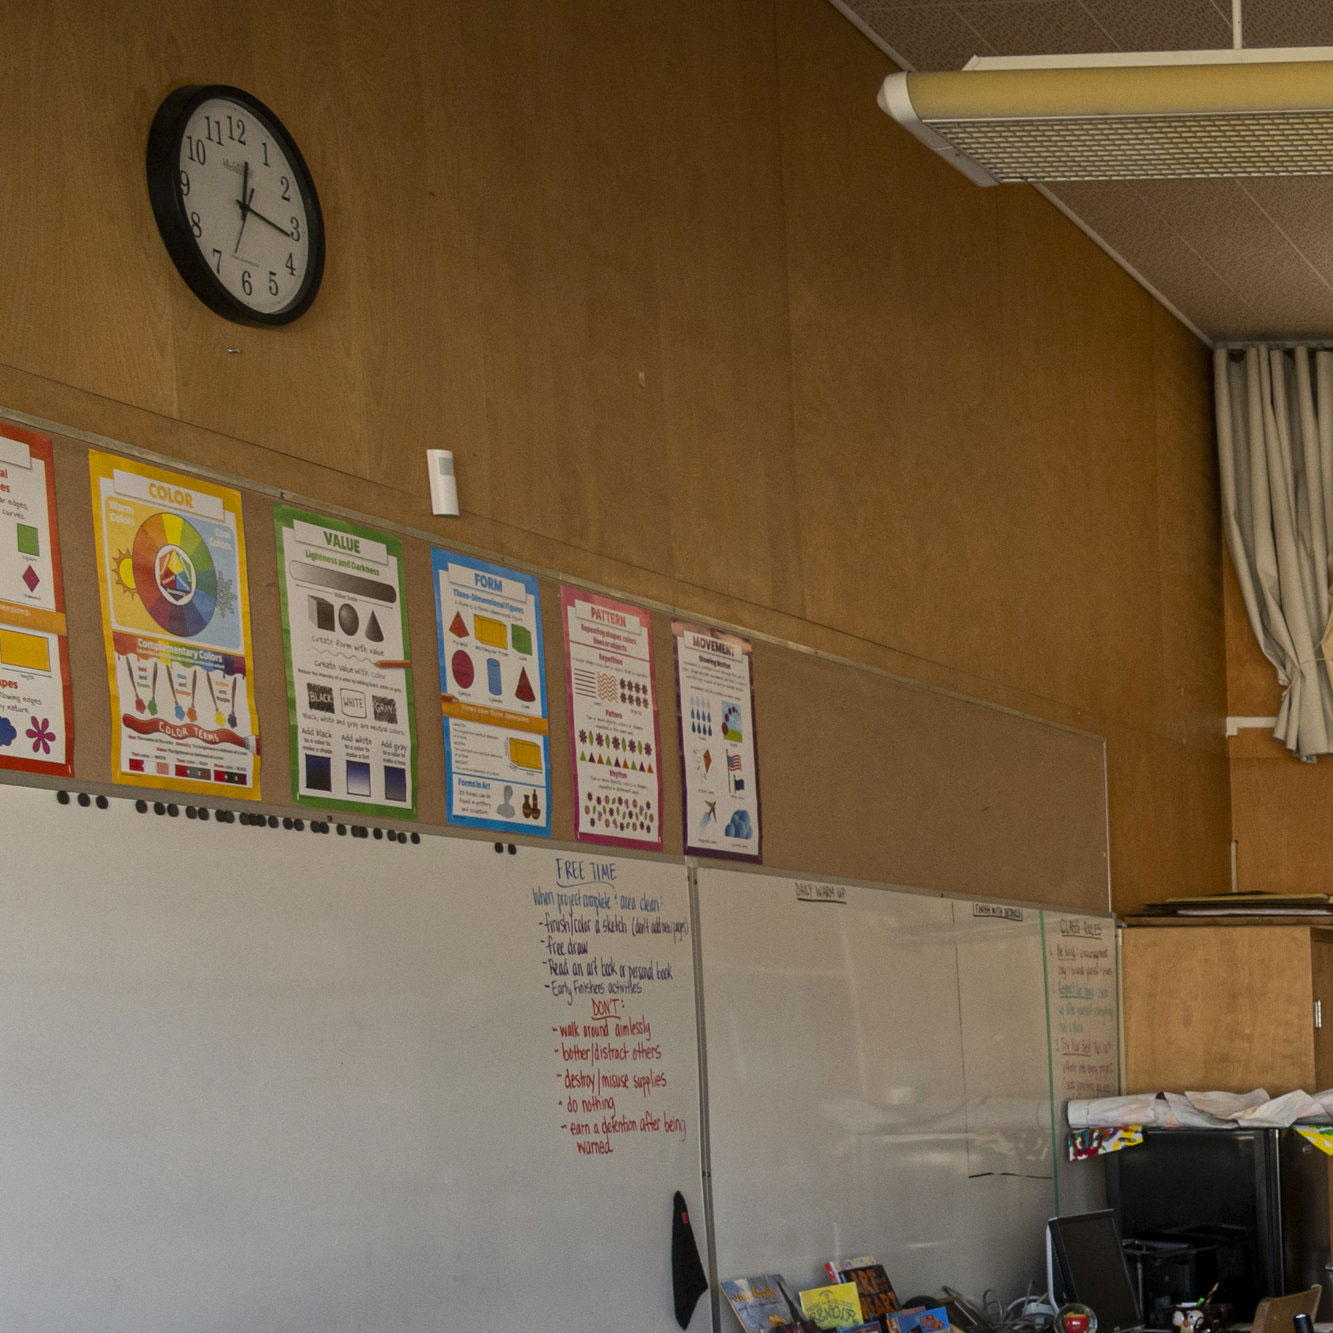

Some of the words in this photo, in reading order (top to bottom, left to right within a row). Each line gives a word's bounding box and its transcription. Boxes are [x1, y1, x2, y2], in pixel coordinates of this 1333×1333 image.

[205, 115, 224, 146] 11
[227, 116, 246, 146] 12
[187, 135, 206, 165] 10
[262, 142, 271, 168] 1
[180, 170, 190, 196] 9
[280, 176, 290, 202] 2
[191, 212, 202, 238] 8
[290, 217, 300, 241] 3
[212, 248, 224, 275] 7
[285, 252, 296, 277] 4
[241, 270, 253, 296] 6
[268, 271, 279, 297] 5
[148, 483, 194, 508] COLOR
[323, 531, 361, 554] VALUE
[305, 549, 337, 566] Lightness
[338, 559, 351, 569] and
[351, 561, 380, 576] Darkness
[474, 573, 503, 592] FORM
[591, 606, 626, 627] PATTERN
[137, 638, 199, 659] Complementary
[199, 649, 223, 663] Colors
[693, 635, 735, 657] MOVEMENT
[309, 691, 332, 703] BLACK
[342, 696, 364, 709] WHITE
[375, 703, 394, 714] GRAY
[605, 709, 623, 719] Pattern
[158, 721, 188, 739] COLOR
[193, 727, 220, 743] TERMS
[302, 728, 315, 736] Add
[316, 729, 333, 739] black
[341, 734, 354, 743] Add
[355, 736, 372, 746] white
[381, 741, 393, 750] Add
[393, 743, 408, 754] gray
[458, 778, 476, 788] Forms
[556, 858, 585, 880] FREE
[590, 862, 616, 880] TIME
[532, 886, 555, 906] When
[556, 888, 581, 917] project
[582, 891, 611, 917] complete
[620, 895, 636, 911] area
[795, 882, 813, 897] DAILY
[815, 884, 836, 899] WARM
[837, 887, 846, 899] UP
[545, 912, 590, 936] finish/color
[602, 913, 627, 934] sketch
[1061, 918, 1080, 934] CLASS
[546, 935, 566, 955] free
[567, 937, 588, 955] draw
[548, 958, 569, 976] Read
[572, 962, 583, 976] an
[586, 956, 598, 977] art
[601, 956, 618, 977] book
[619, 963, 626, 978] or
[628, 960, 654, 983] personal
[656, 962, 673, 981] book
[551, 980, 573, 1005] Early
[573, 979, 605, 995] Finishers
[608, 980, 642, 994] activities
[560, 1021, 580, 1038] walk
[583, 1019, 609, 1039] around
[615, 1015, 651, 1041] aimlessly
[561, 1042, 629, 1066] bother/distract
[632, 1042, 662, 1061] others
[564, 1068, 629, 1095] destroy/misuse
[633, 1068, 667, 1098] supplies
[567, 1095, 578, 1113] do
[582, 1096, 616, 1120] nothing
[570, 1122, 591, 1136] earn
[594, 1123, 600, 1134] a
[602, 1115, 637, 1134] detention
[640, 1110, 660, 1132] after
[663, 1112, 687, 1142] being
[577, 1135, 614, 1155] warned
[808, 1305, 857, 1323] RENOIR
